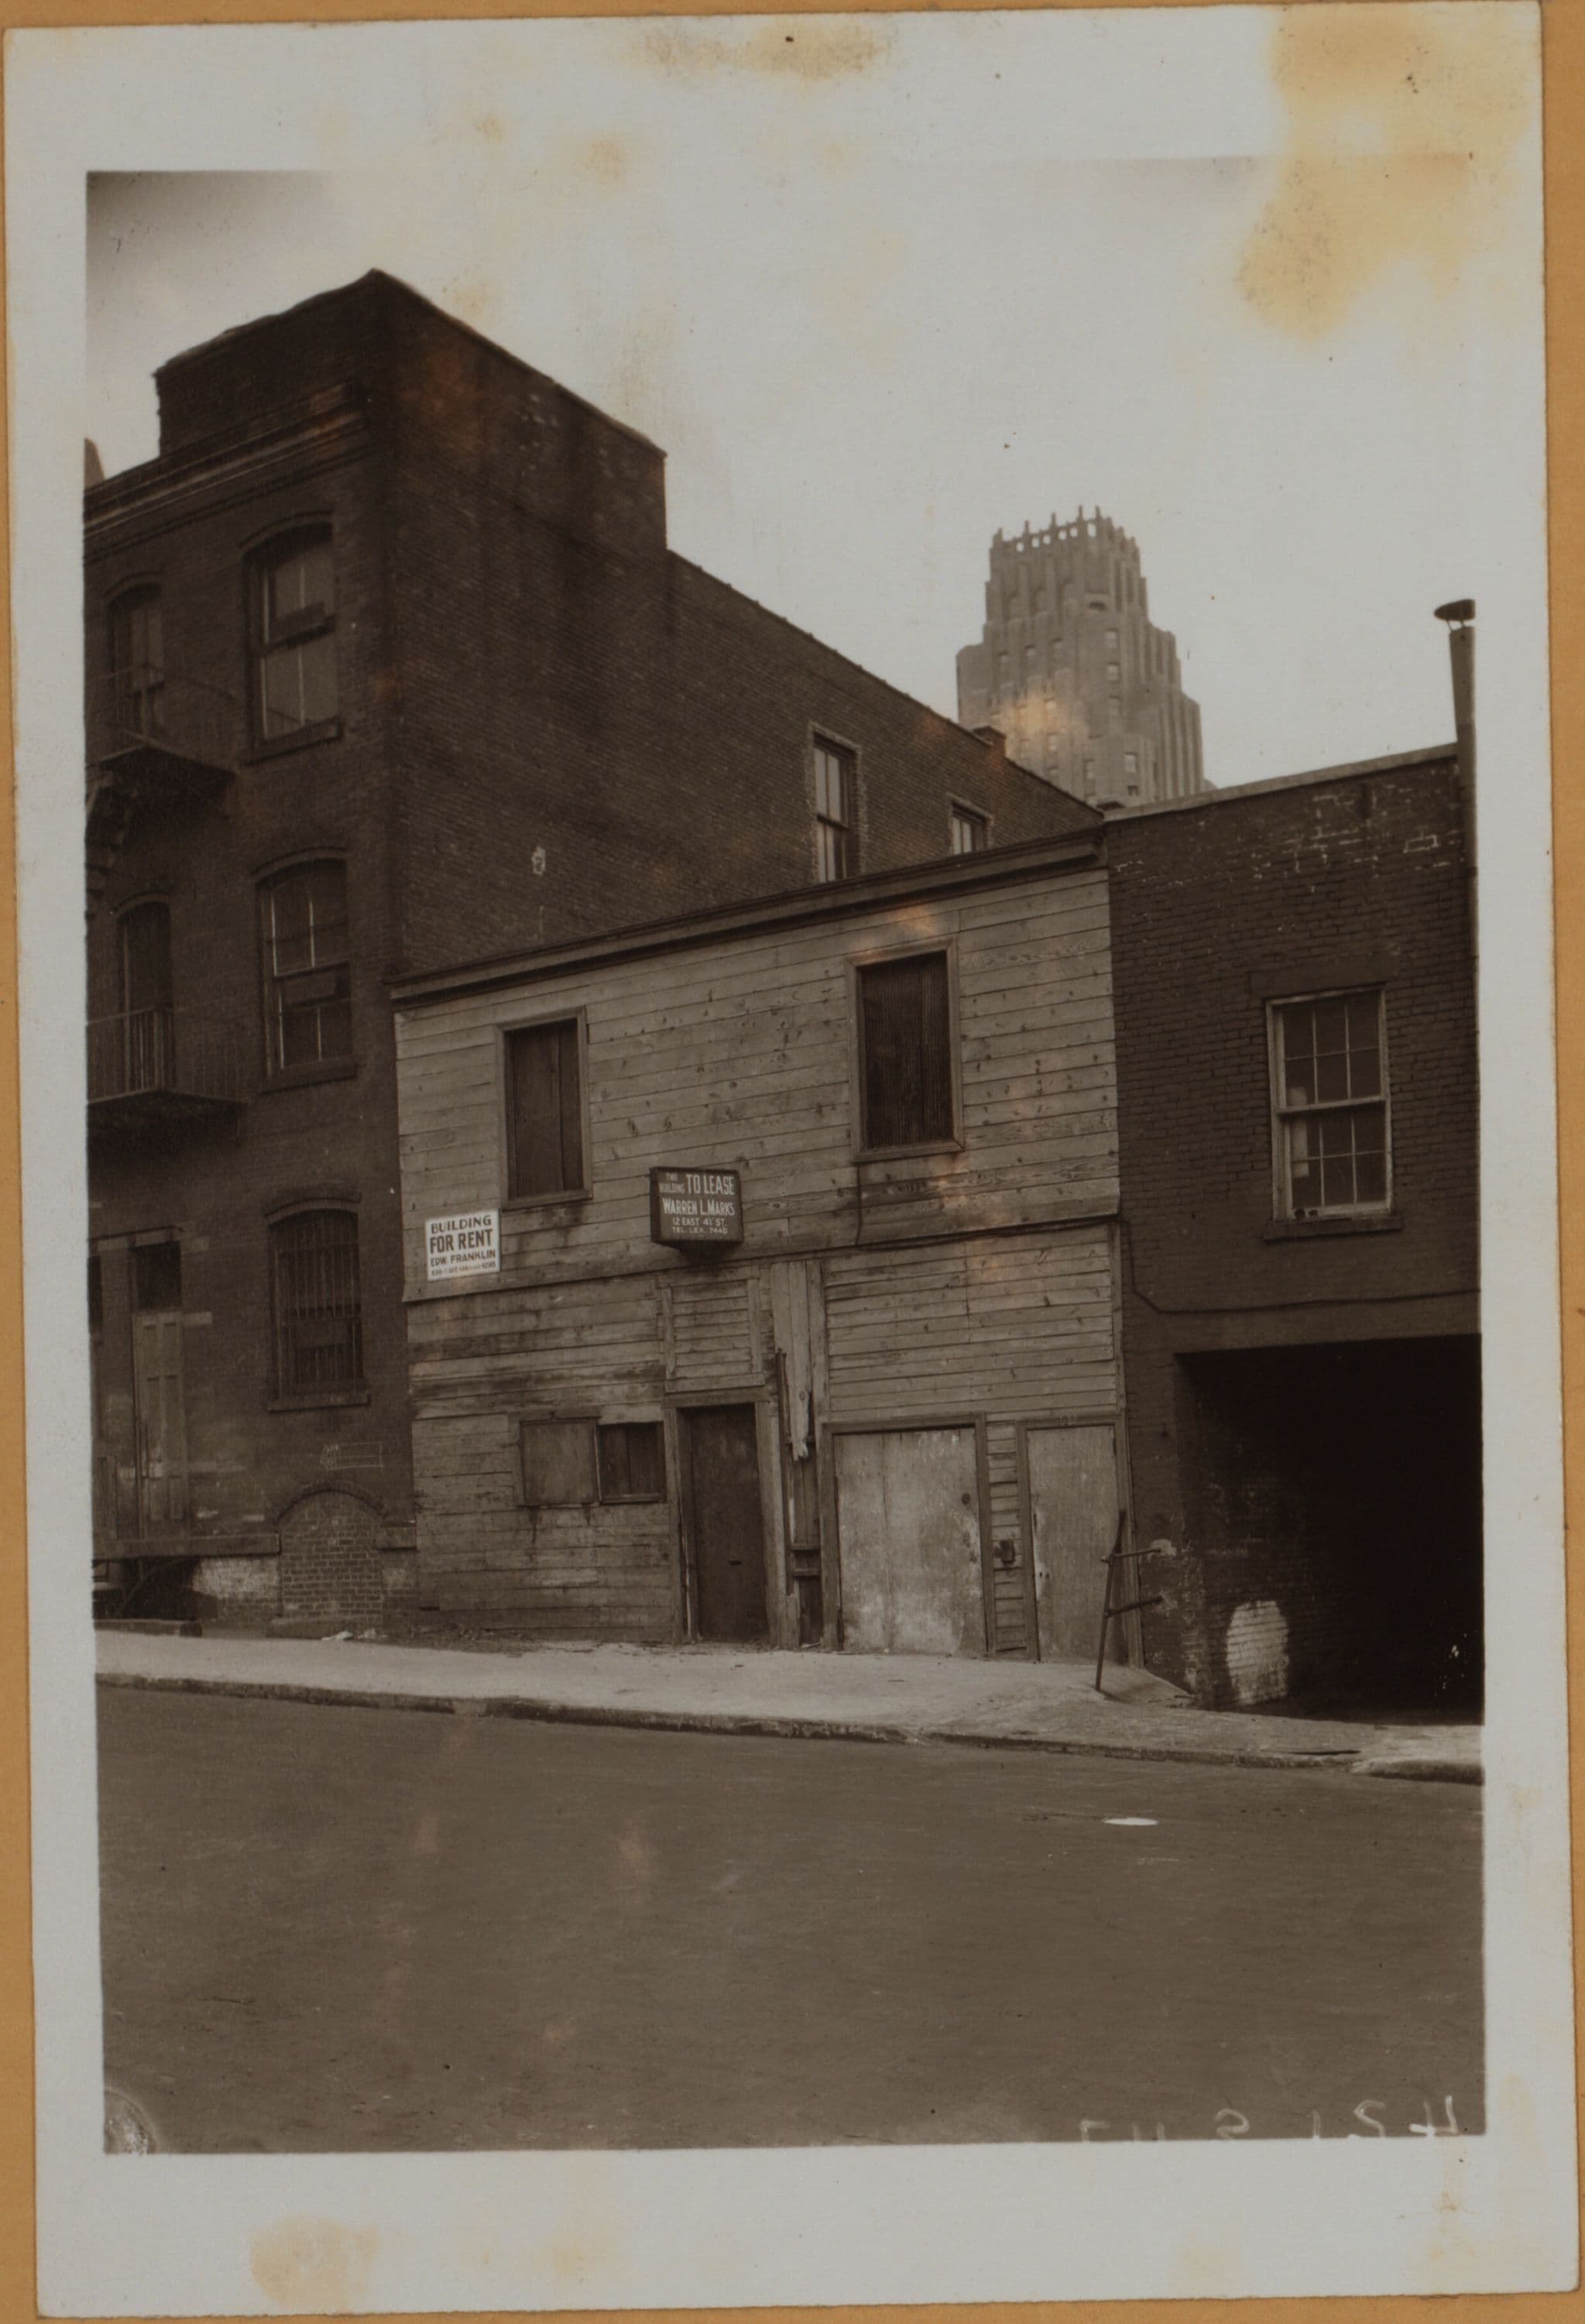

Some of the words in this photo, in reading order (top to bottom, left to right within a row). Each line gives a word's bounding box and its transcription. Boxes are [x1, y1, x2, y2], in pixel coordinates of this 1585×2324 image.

[686, 1174, 701, 1194] TO
[703, 1175, 735, 1195] LEASE
[663, 1197, 698, 1215] WARREN
[431, 1215, 492, 1234] BUILDING
[673, 1217, 680, 1226] 12
[682, 1217, 699, 1226] EAST
[430, 1234, 454, 1254] FOR
[458, 1229, 492, 1249] RENT
[451, 1250, 496, 1264] FRANKLIN
